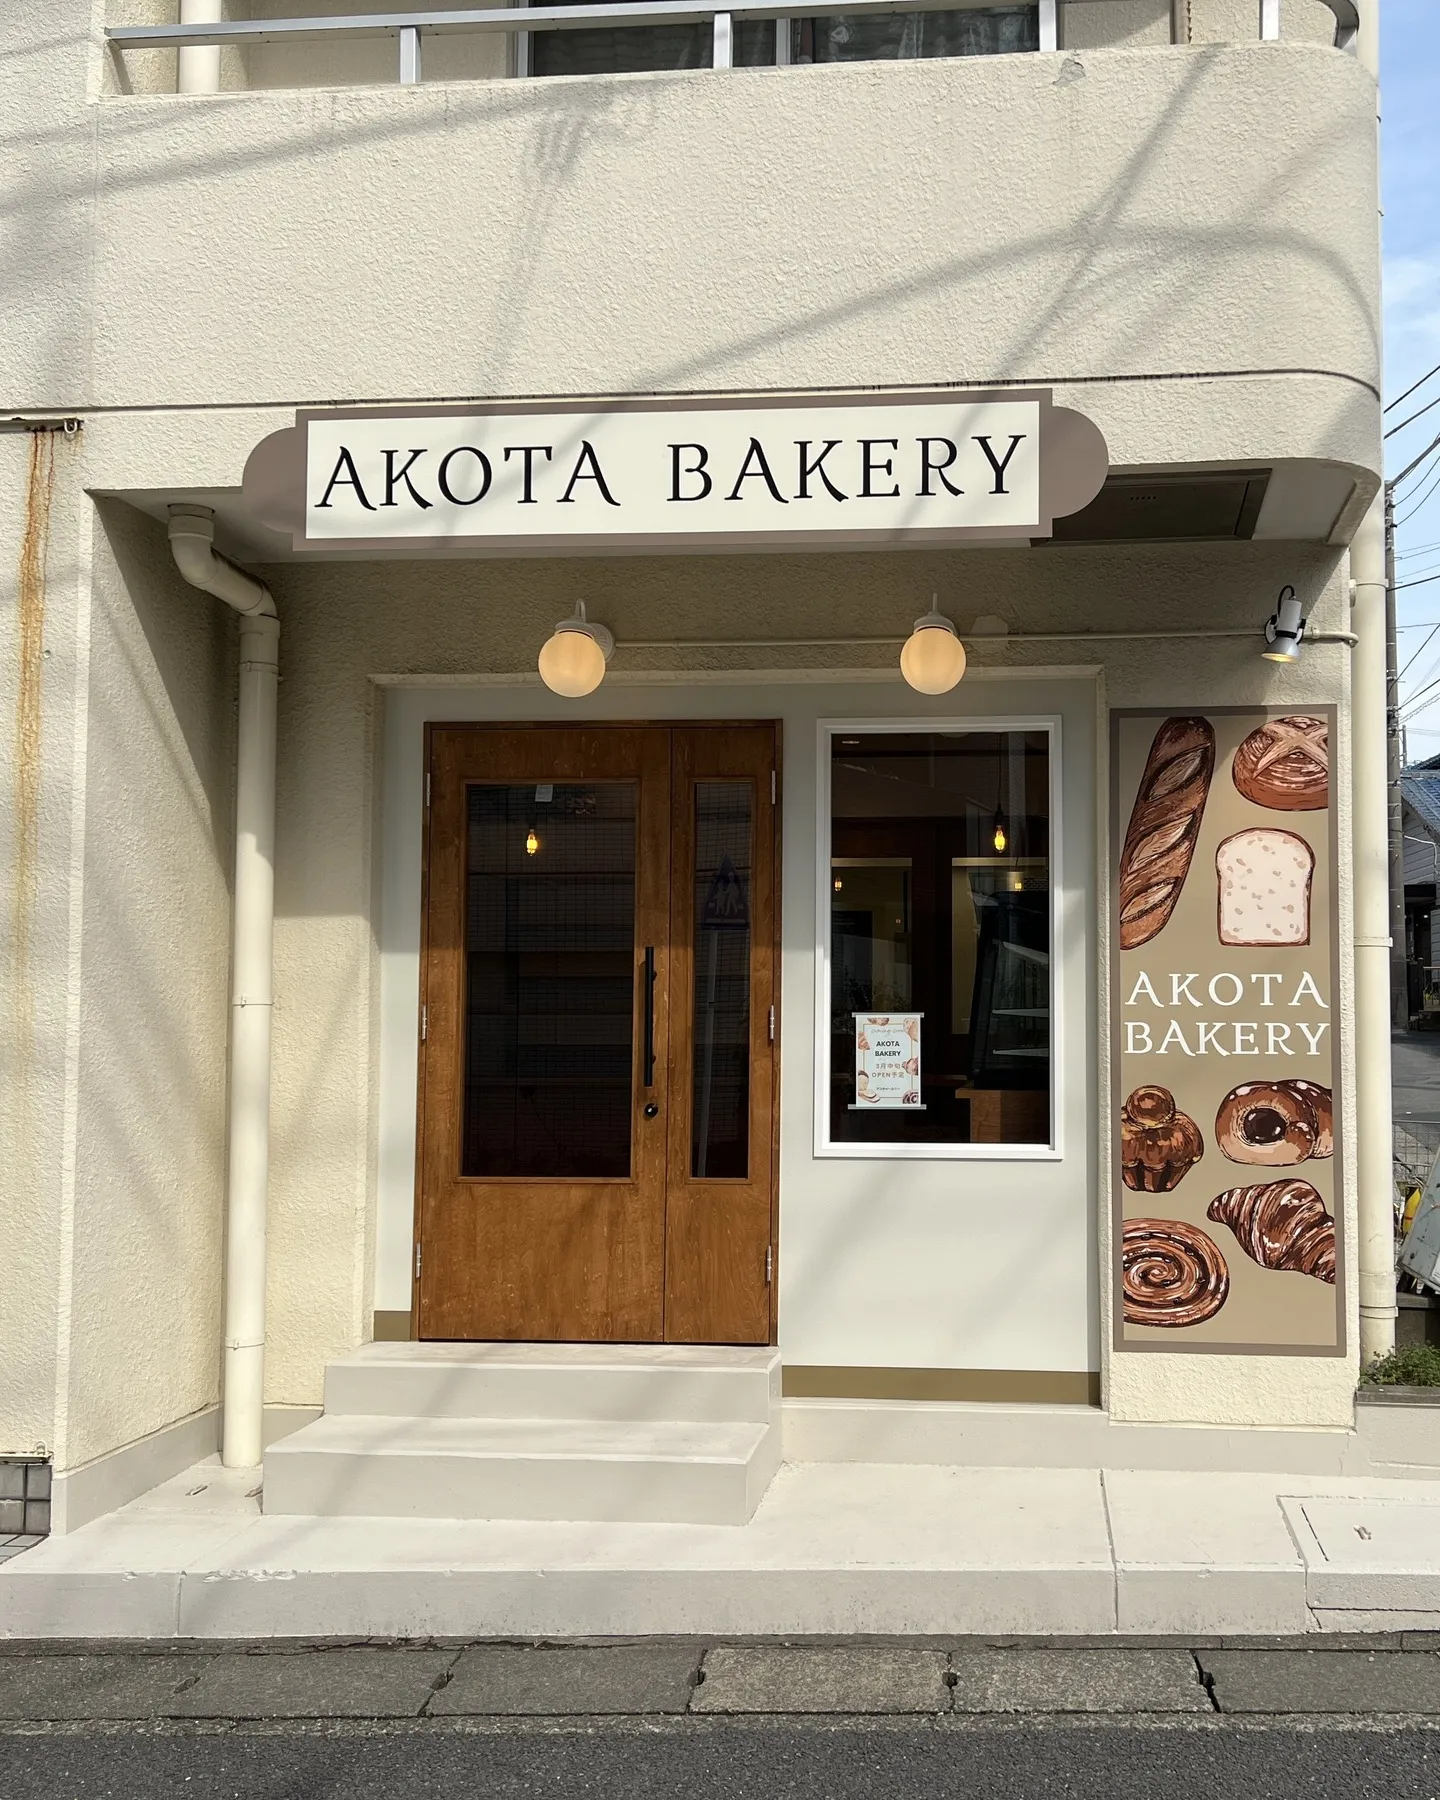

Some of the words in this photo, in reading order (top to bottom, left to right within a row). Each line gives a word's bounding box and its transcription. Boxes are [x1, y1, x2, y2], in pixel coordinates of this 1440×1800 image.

[315, 441, 620, 510] AKOTA
[667, 435, 1026, 503] BAKERY
[1126, 971, 1329, 1008] AKOTA
[1125, 1020, 1330, 1056] BAKERY
